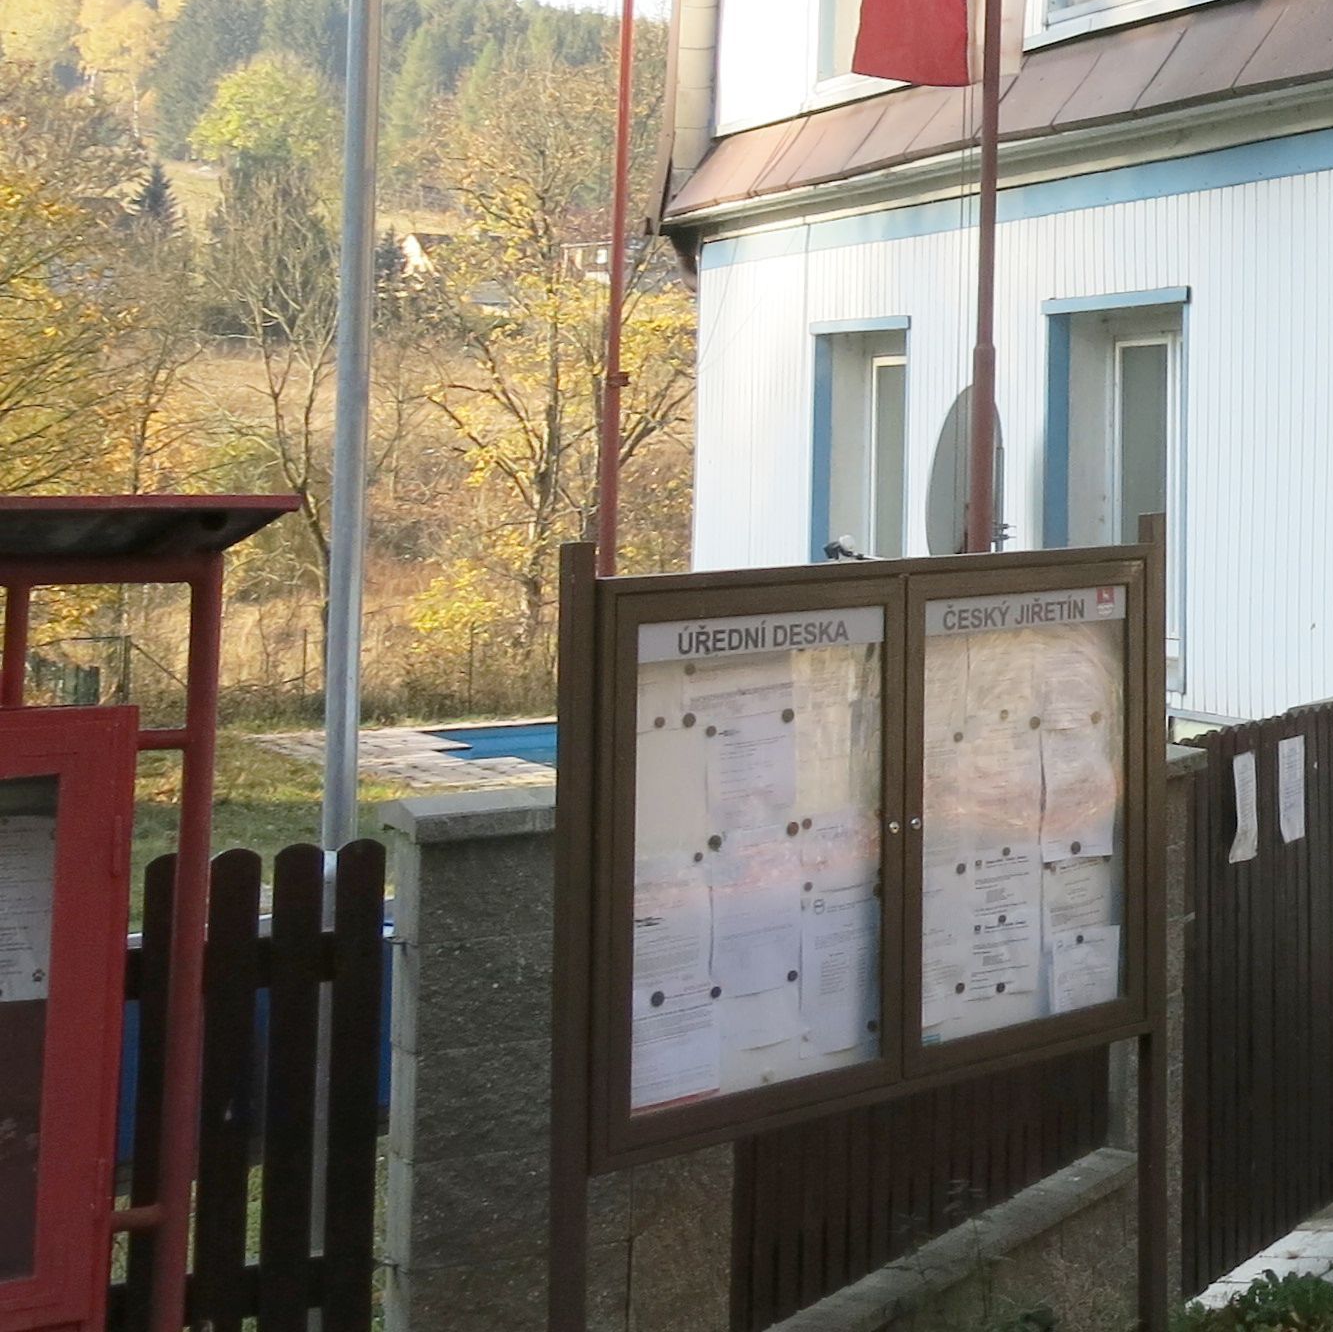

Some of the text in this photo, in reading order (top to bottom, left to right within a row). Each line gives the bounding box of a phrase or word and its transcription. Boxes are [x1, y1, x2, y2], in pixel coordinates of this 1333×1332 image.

[943, 594, 1085, 631] ČESKÝ JIŘETÍN
[677, 620, 849, 655] ÚŘEDNÍ DESKA
